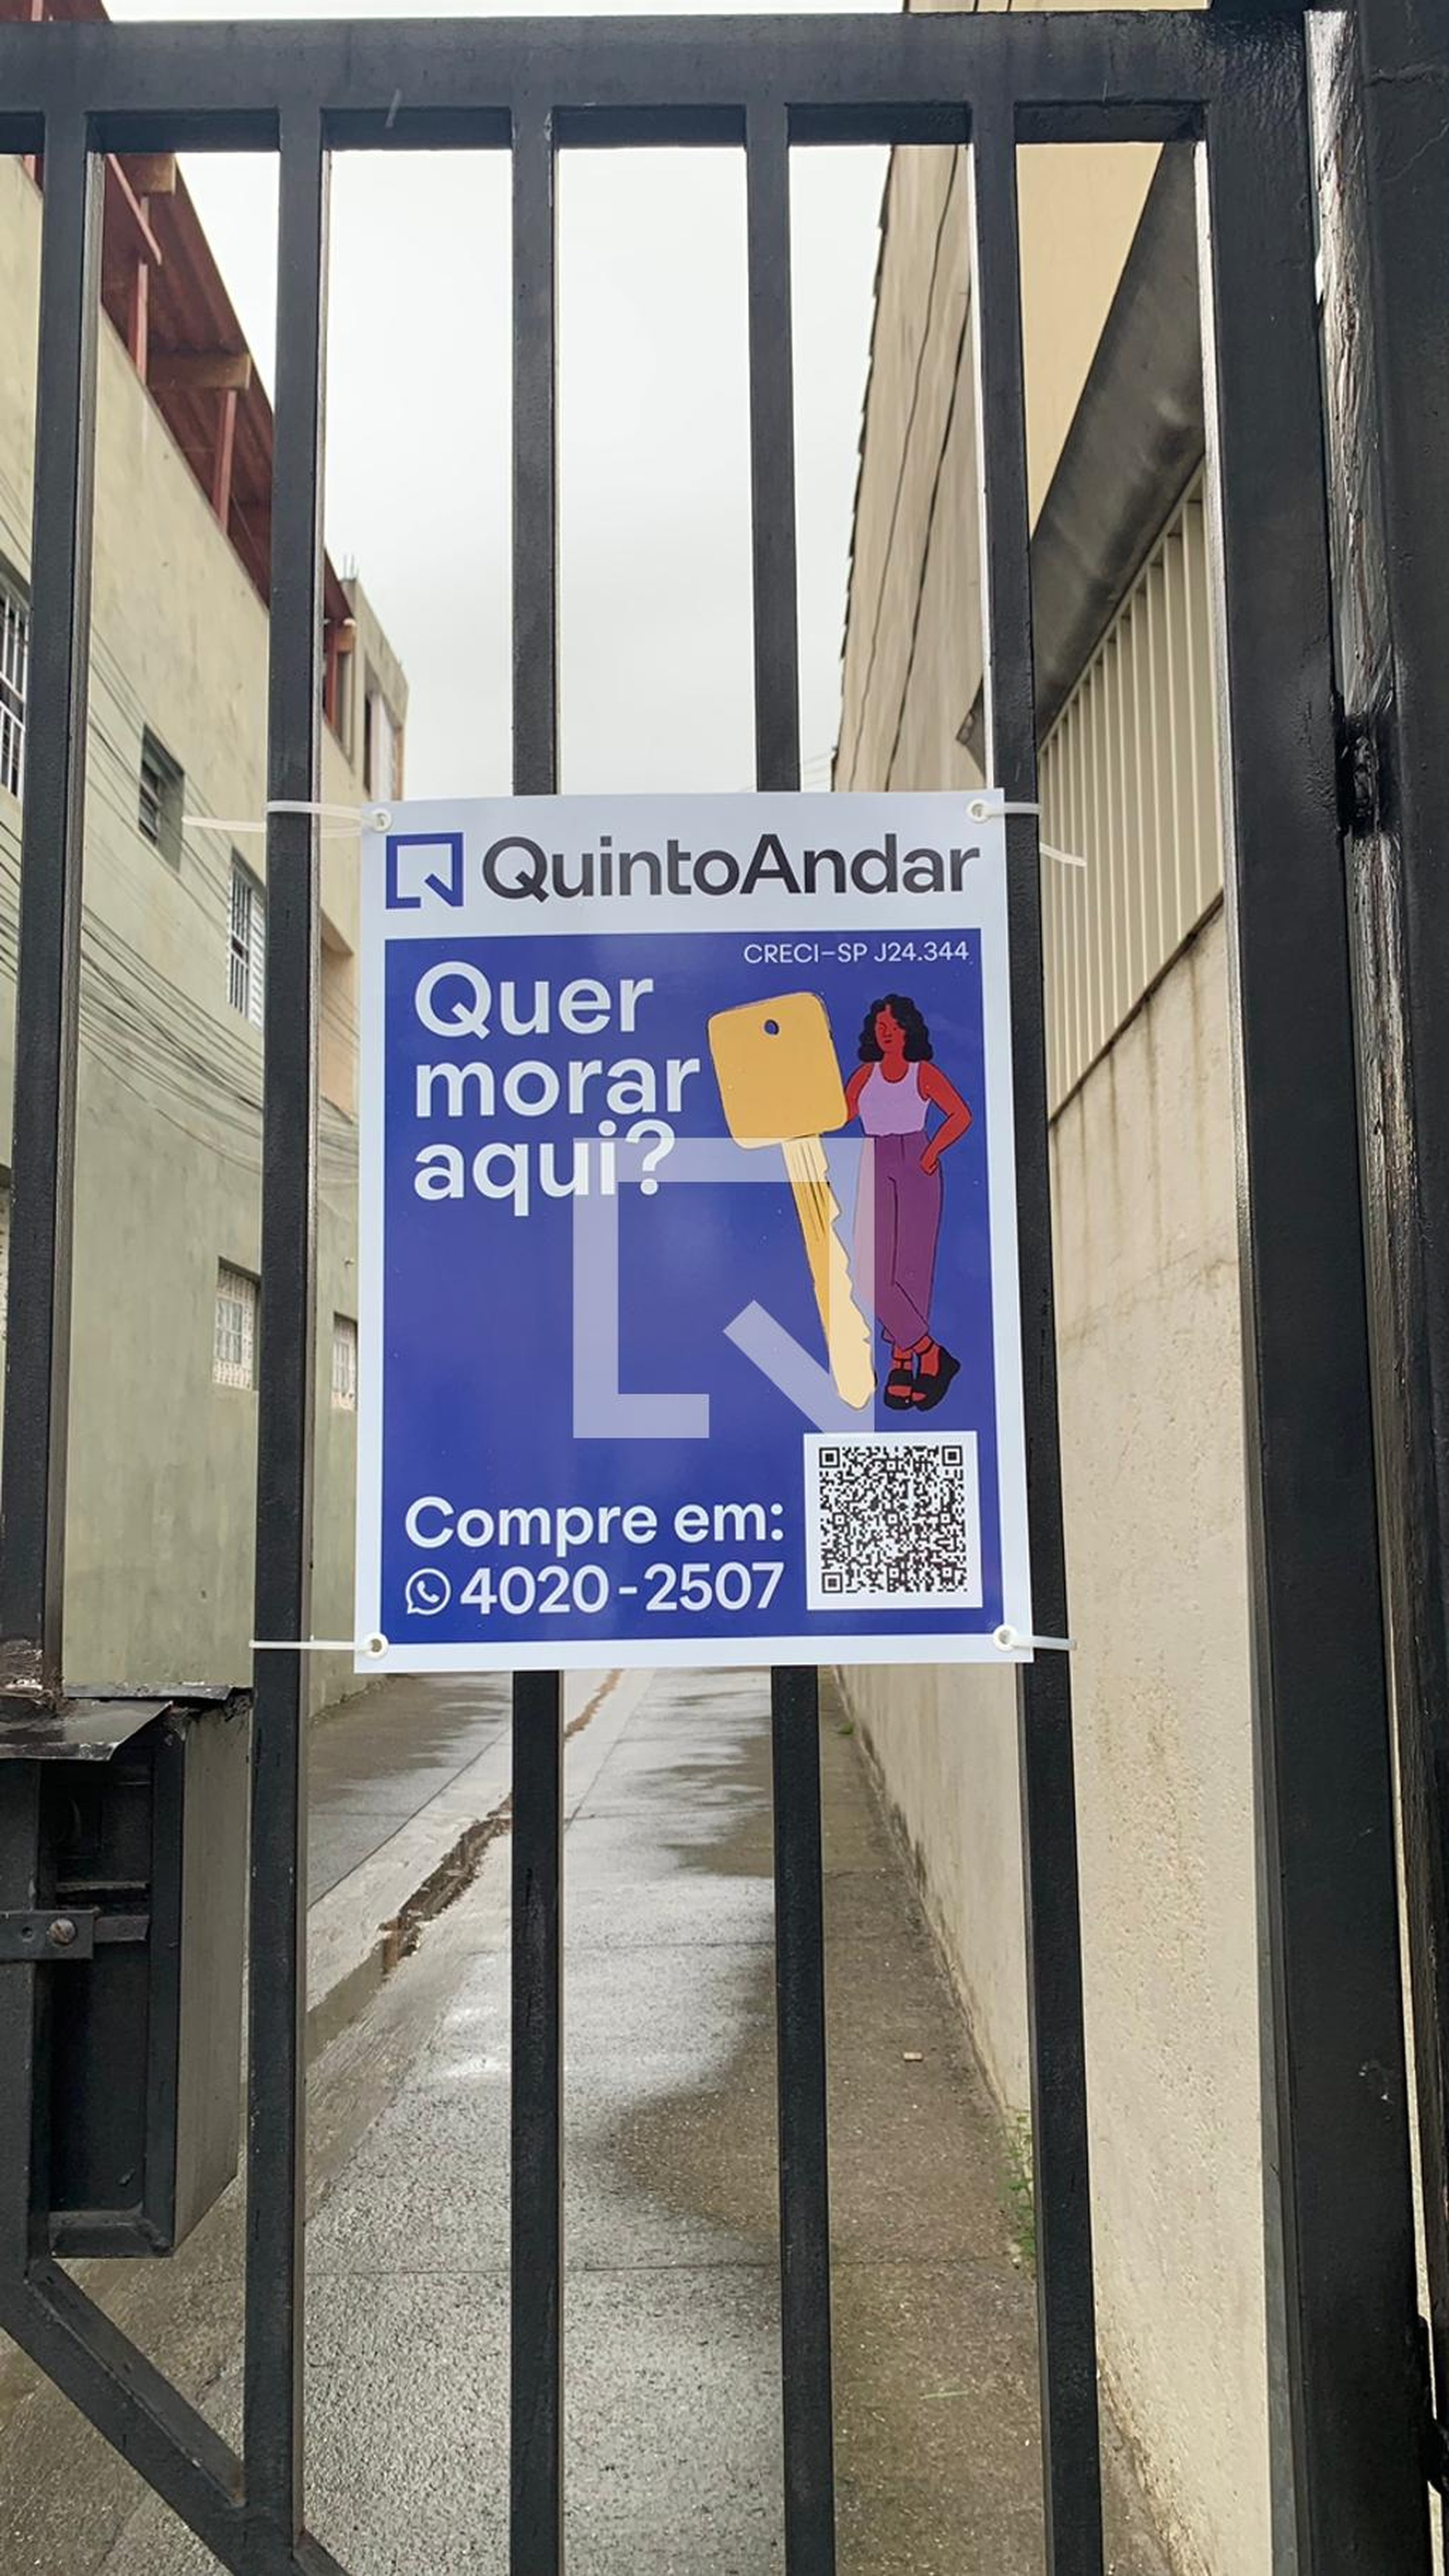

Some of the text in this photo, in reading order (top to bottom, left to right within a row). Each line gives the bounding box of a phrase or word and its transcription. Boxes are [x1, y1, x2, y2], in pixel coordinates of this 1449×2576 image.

[482, 833, 980, 903] QuintoAndar
[743, 941, 969, 964] CRECI-SP J24.344
[415, 961, 654, 1040] Quer
[416, 1058, 701, 1118] morar
[414, 1120, 675, 1216] aqui?
[405, 1496, 784, 1558] Compre em:
